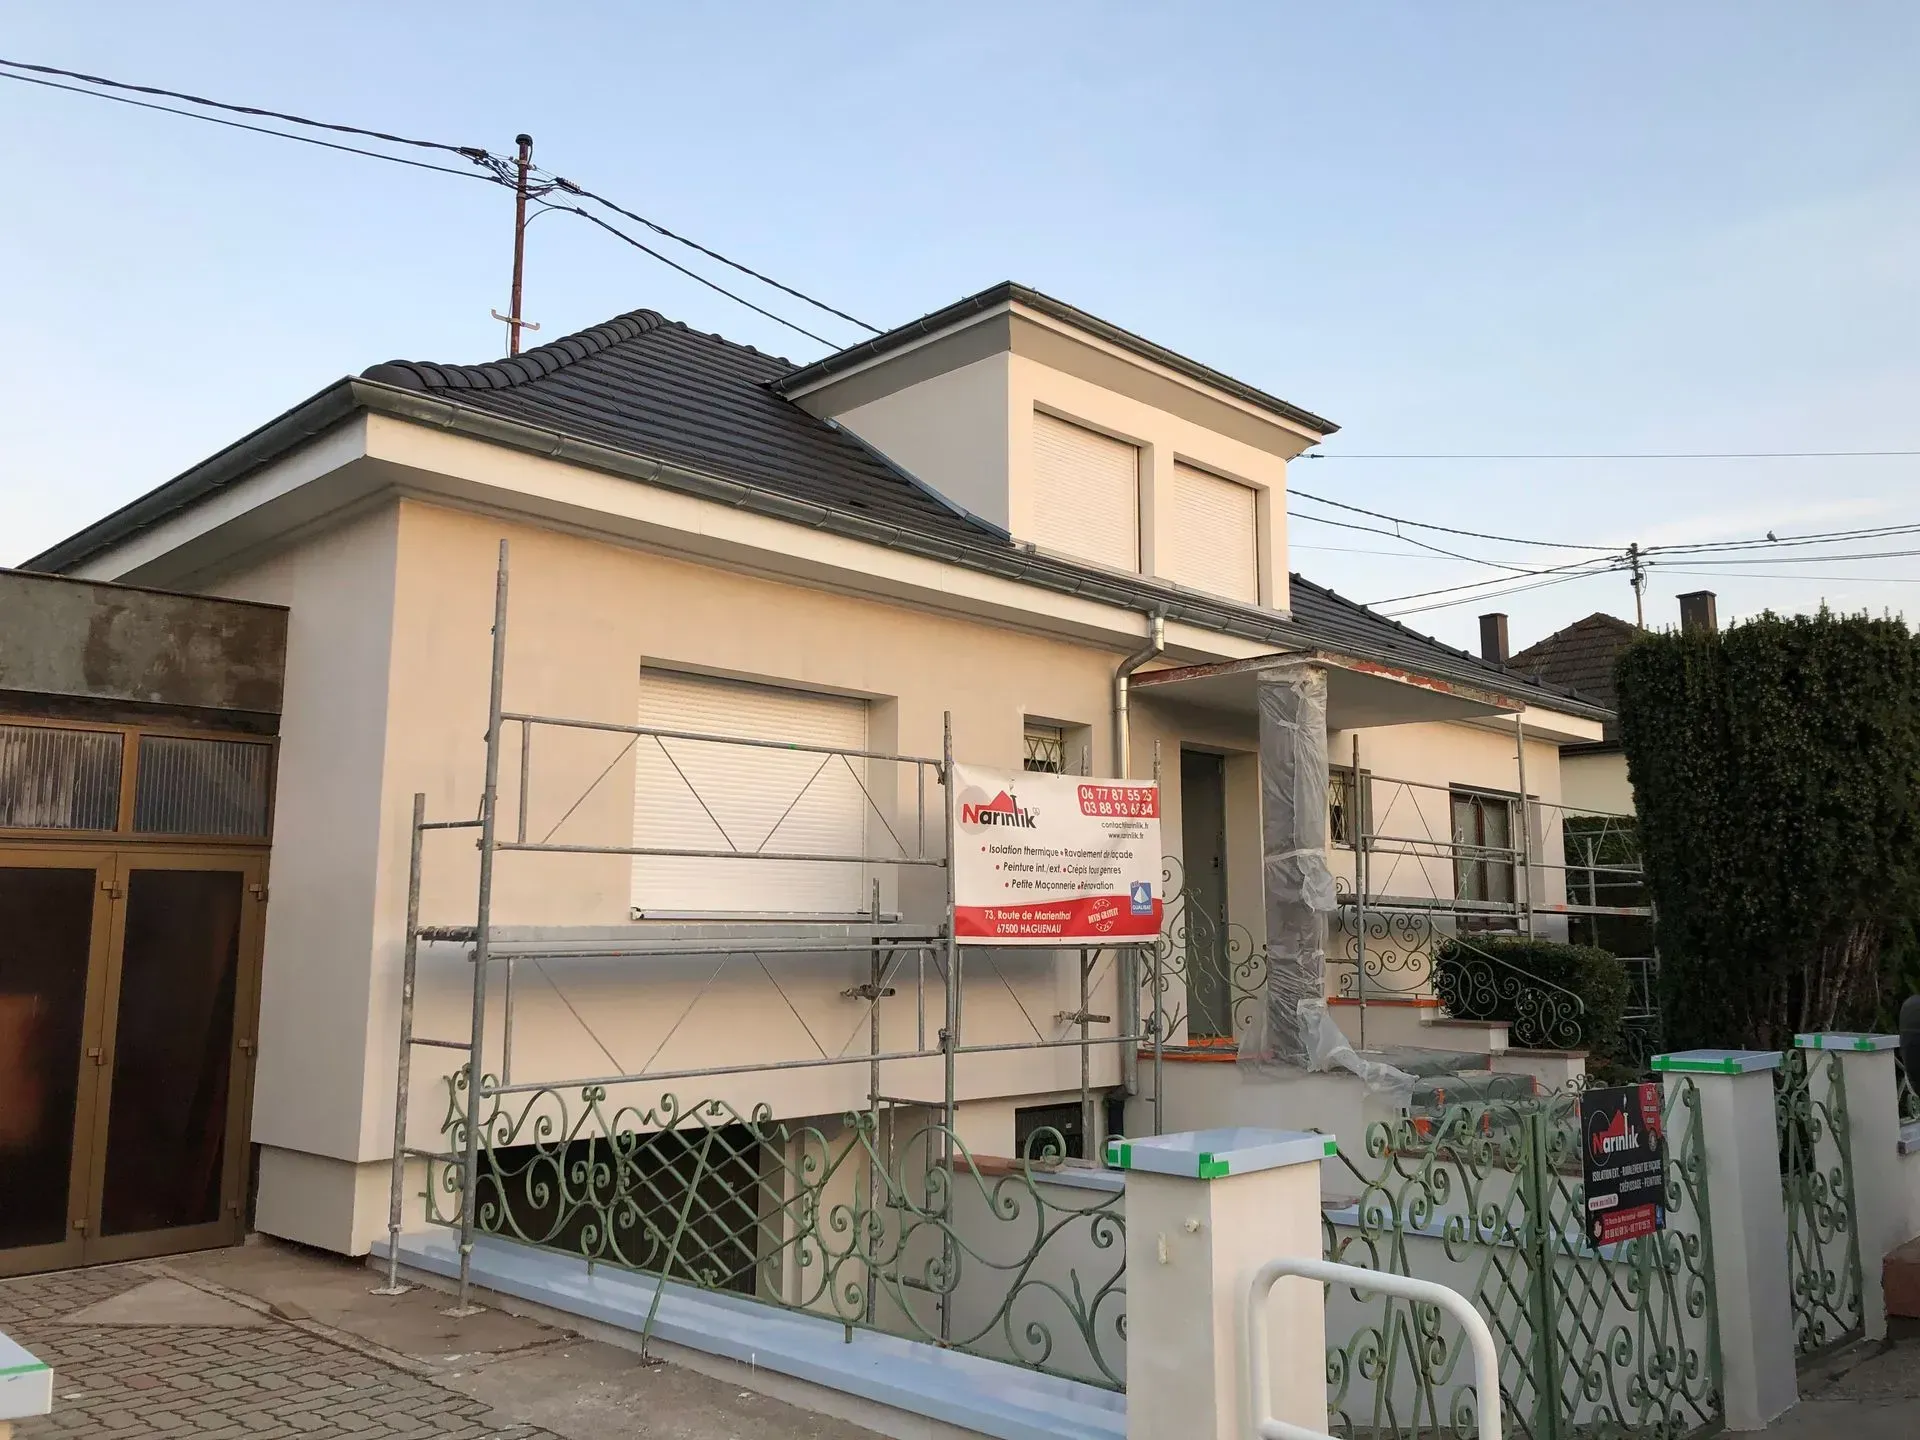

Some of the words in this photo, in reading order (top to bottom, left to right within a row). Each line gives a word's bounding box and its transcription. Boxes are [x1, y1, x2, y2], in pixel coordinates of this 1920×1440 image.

[1081, 787, 1094, 800] 06
[1096, 788, 1108, 800] 77
[1111, 789, 1123, 801] 87
[1127, 789, 1140, 801] 55
[1084, 801, 1097, 814] 03
[1099, 802, 1112, 814] 88
[1114, 802, 1128, 815] 93
[1140, 803, 1153, 815] 34
[989, 844, 1022, 855] Isolation
[1024, 846, 1059, 858] thermique
[1064, 848, 1103, 859] Ravalement
[1003, 861, 1034, 872] Peinture
[1035, 863, 1061, 873] int./ext.
[1067, 864, 1087, 875] Crépis
[1099, 867, 1121, 876] genres
[1011, 879, 1033, 889] Petite
[1035, 880, 1075, 891] Maçonnerie
[1081, 880, 1113, 889] Rénovation
[985, 910, 996, 921] 73,
[997, 911, 1021, 920] Route
[1022, 911, 1033, 920] de
[1034, 910, 1071, 921] Marienthal
[996, 924, 1018, 934] 67500
[1020, 924, 1061, 934] HAGUENAU
